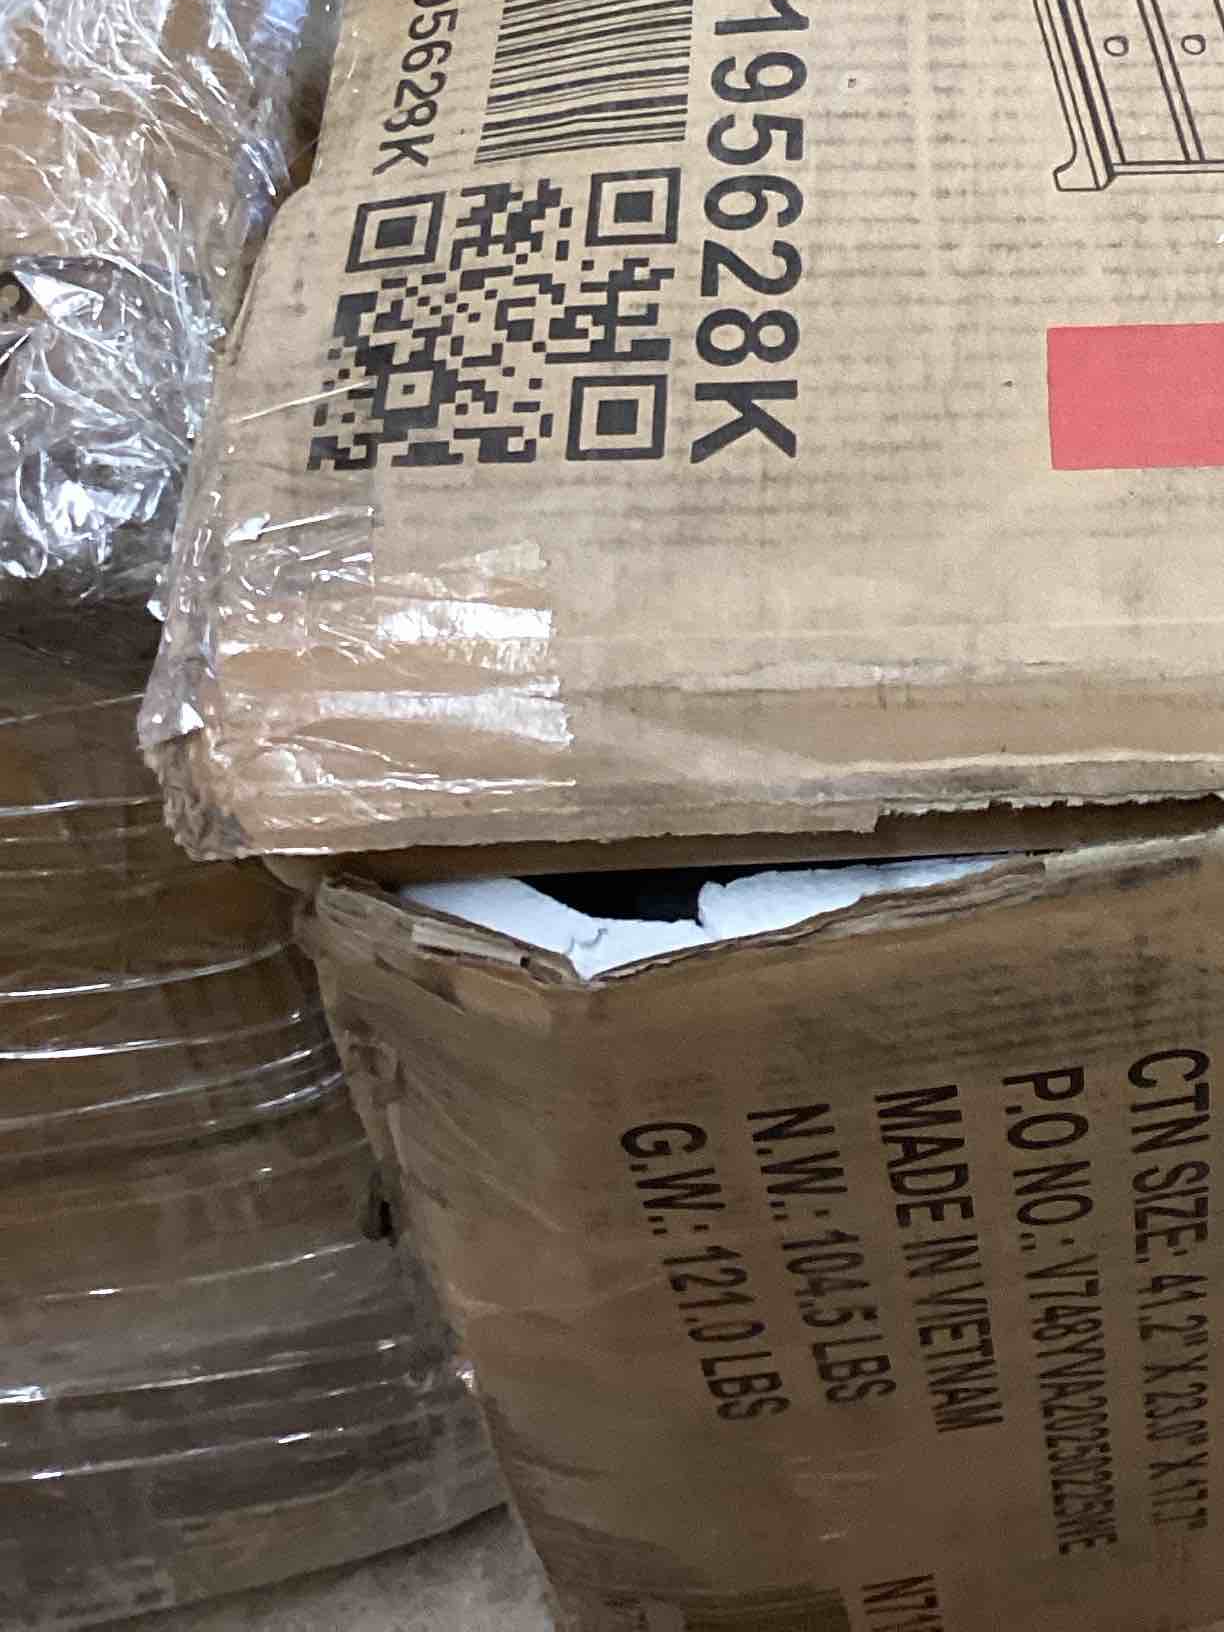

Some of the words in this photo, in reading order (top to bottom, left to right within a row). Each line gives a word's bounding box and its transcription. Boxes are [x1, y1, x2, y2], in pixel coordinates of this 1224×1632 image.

[1128, 1049, 1210, 1154] CTN
[874, 1084, 975, 1230] MADE
[902, 1233, 982, 1279] IN
[1132, 1161, 1210, 1264] SIZE:
[662, 1245, 767, 1344] 121.0
[701, 1351, 791, 1421] LBS
[810, 1334, 897, 1405] LBS
[914, 1280, 1003, 1433] VIETNAM
